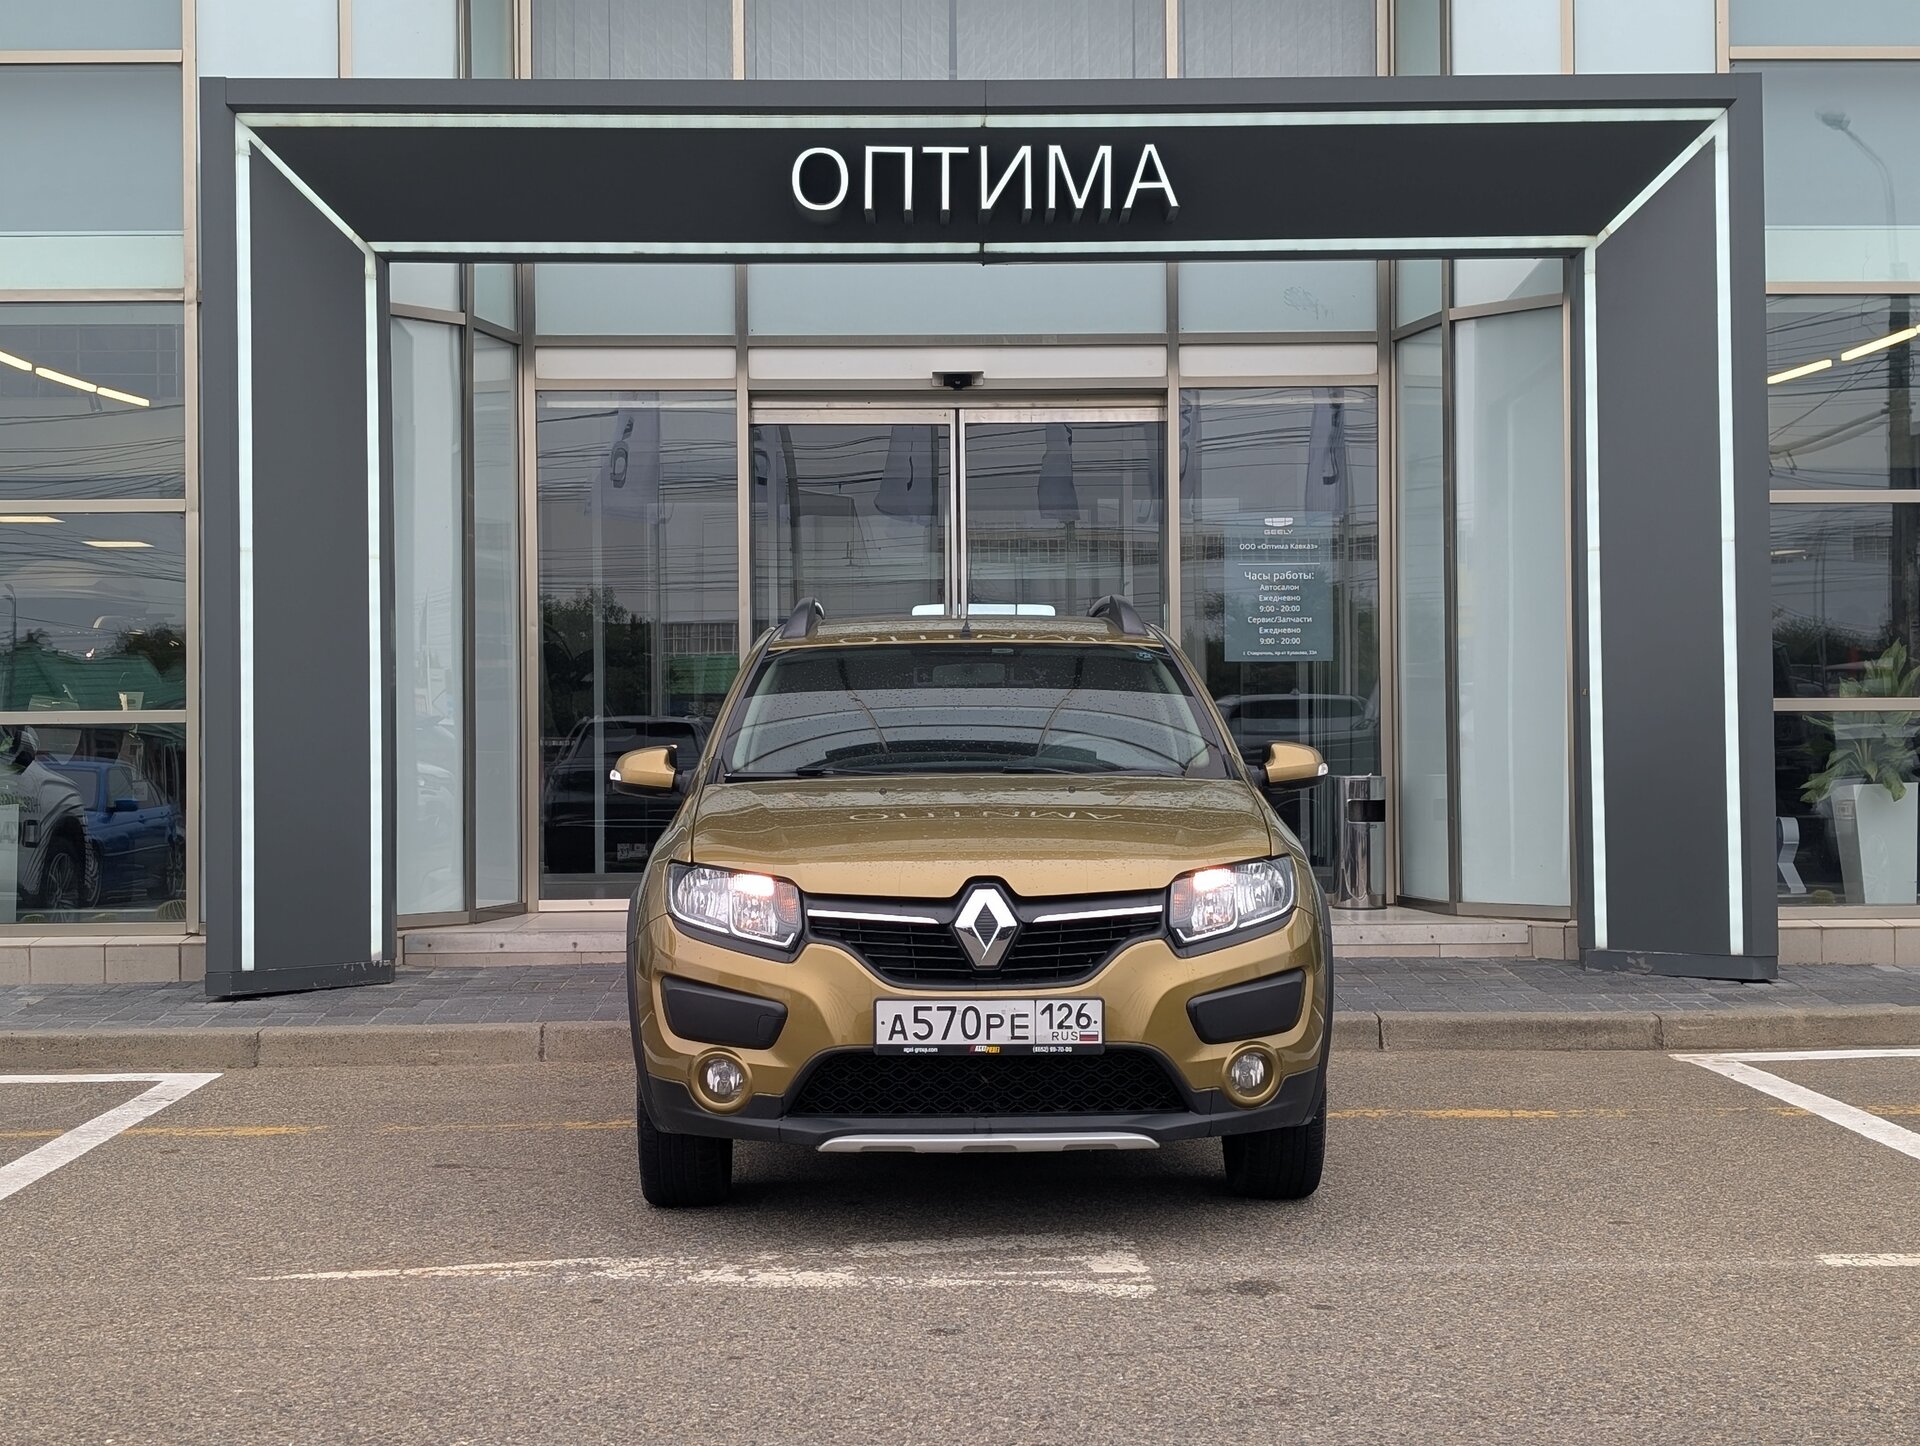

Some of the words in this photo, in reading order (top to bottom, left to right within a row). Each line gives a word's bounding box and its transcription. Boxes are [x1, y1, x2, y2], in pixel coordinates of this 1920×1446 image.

[791, 143, 1181, 212] ОПТИМА
[1244, 571, 1271, 580] Часы
[1273, 570, 1315, 582] работы:
[1258, 594, 1301, 602] Ежедневно
[1247, 616, 1313, 624] Сервис/Запчасти
[1258, 626, 1302, 634] Ежедневно
[1259, 637, 1275, 645] 9:00
[1280, 637, 1301, 645] 20:00
[888, 1005, 1029, 1041] А570РЕ
[1039, 1003, 1092, 1030] 126
[1051, 1031, 1078, 1041] RUS
